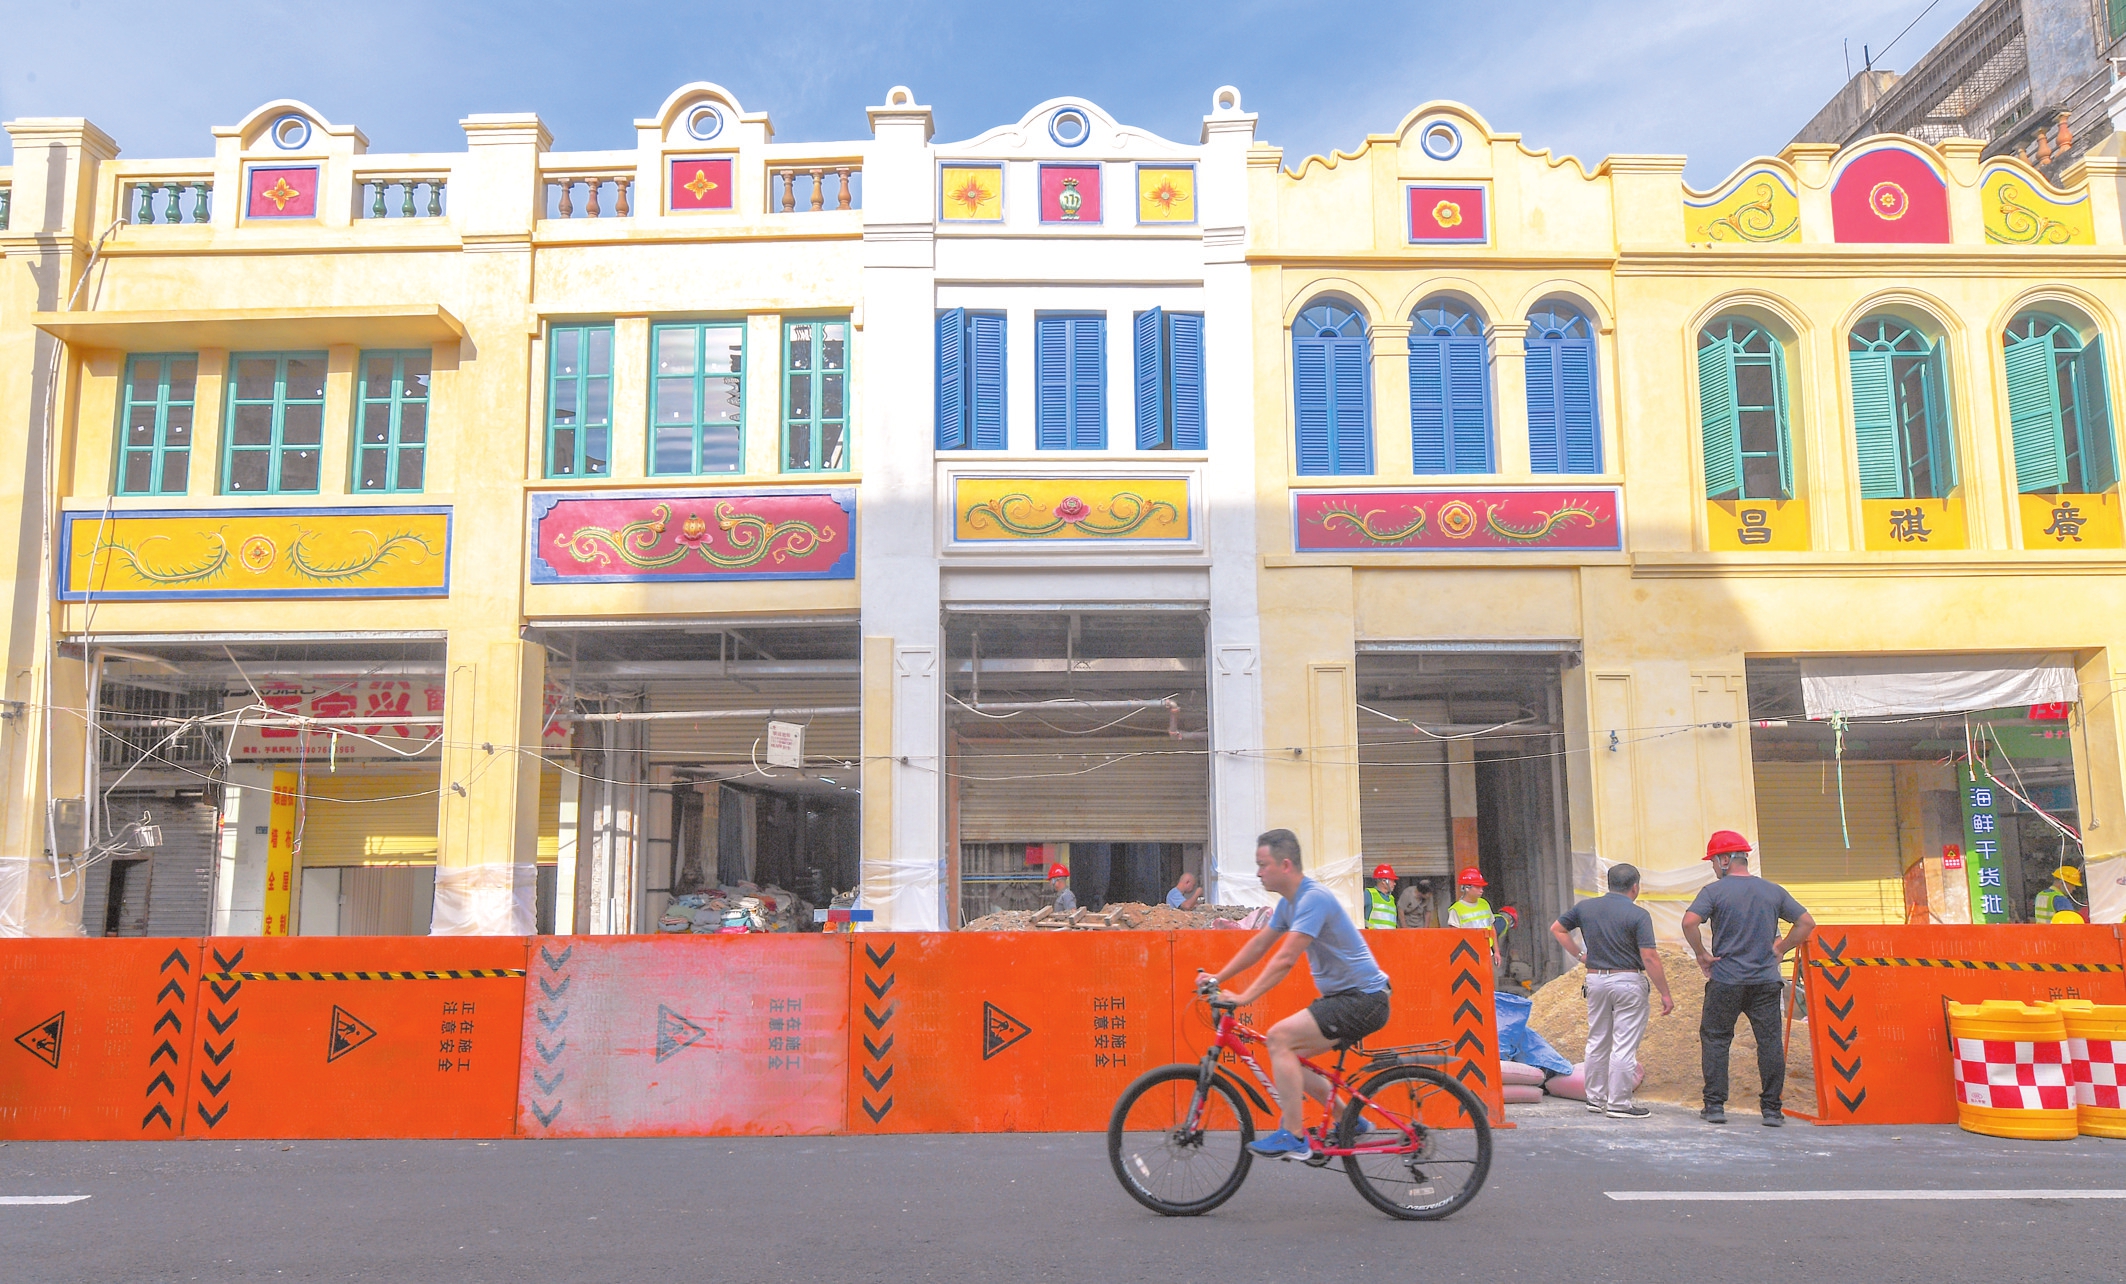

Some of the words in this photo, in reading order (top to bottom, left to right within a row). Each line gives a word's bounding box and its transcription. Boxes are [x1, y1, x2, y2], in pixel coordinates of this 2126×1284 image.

[1737, 509, 1772, 545] 昌
[1970, 787, 2003, 914] 海鲜干货批
[438, 1001, 457, 1072] 注意安全
[458, 1001, 475, 1072] 正在施工
[768, 998, 784, 1070] 注意安全
[785, 998, 802, 1070] 正在施工
[1094, 997, 1110, 1068] 注意安全
[1111, 996, 1126, 1068] 正在施工
